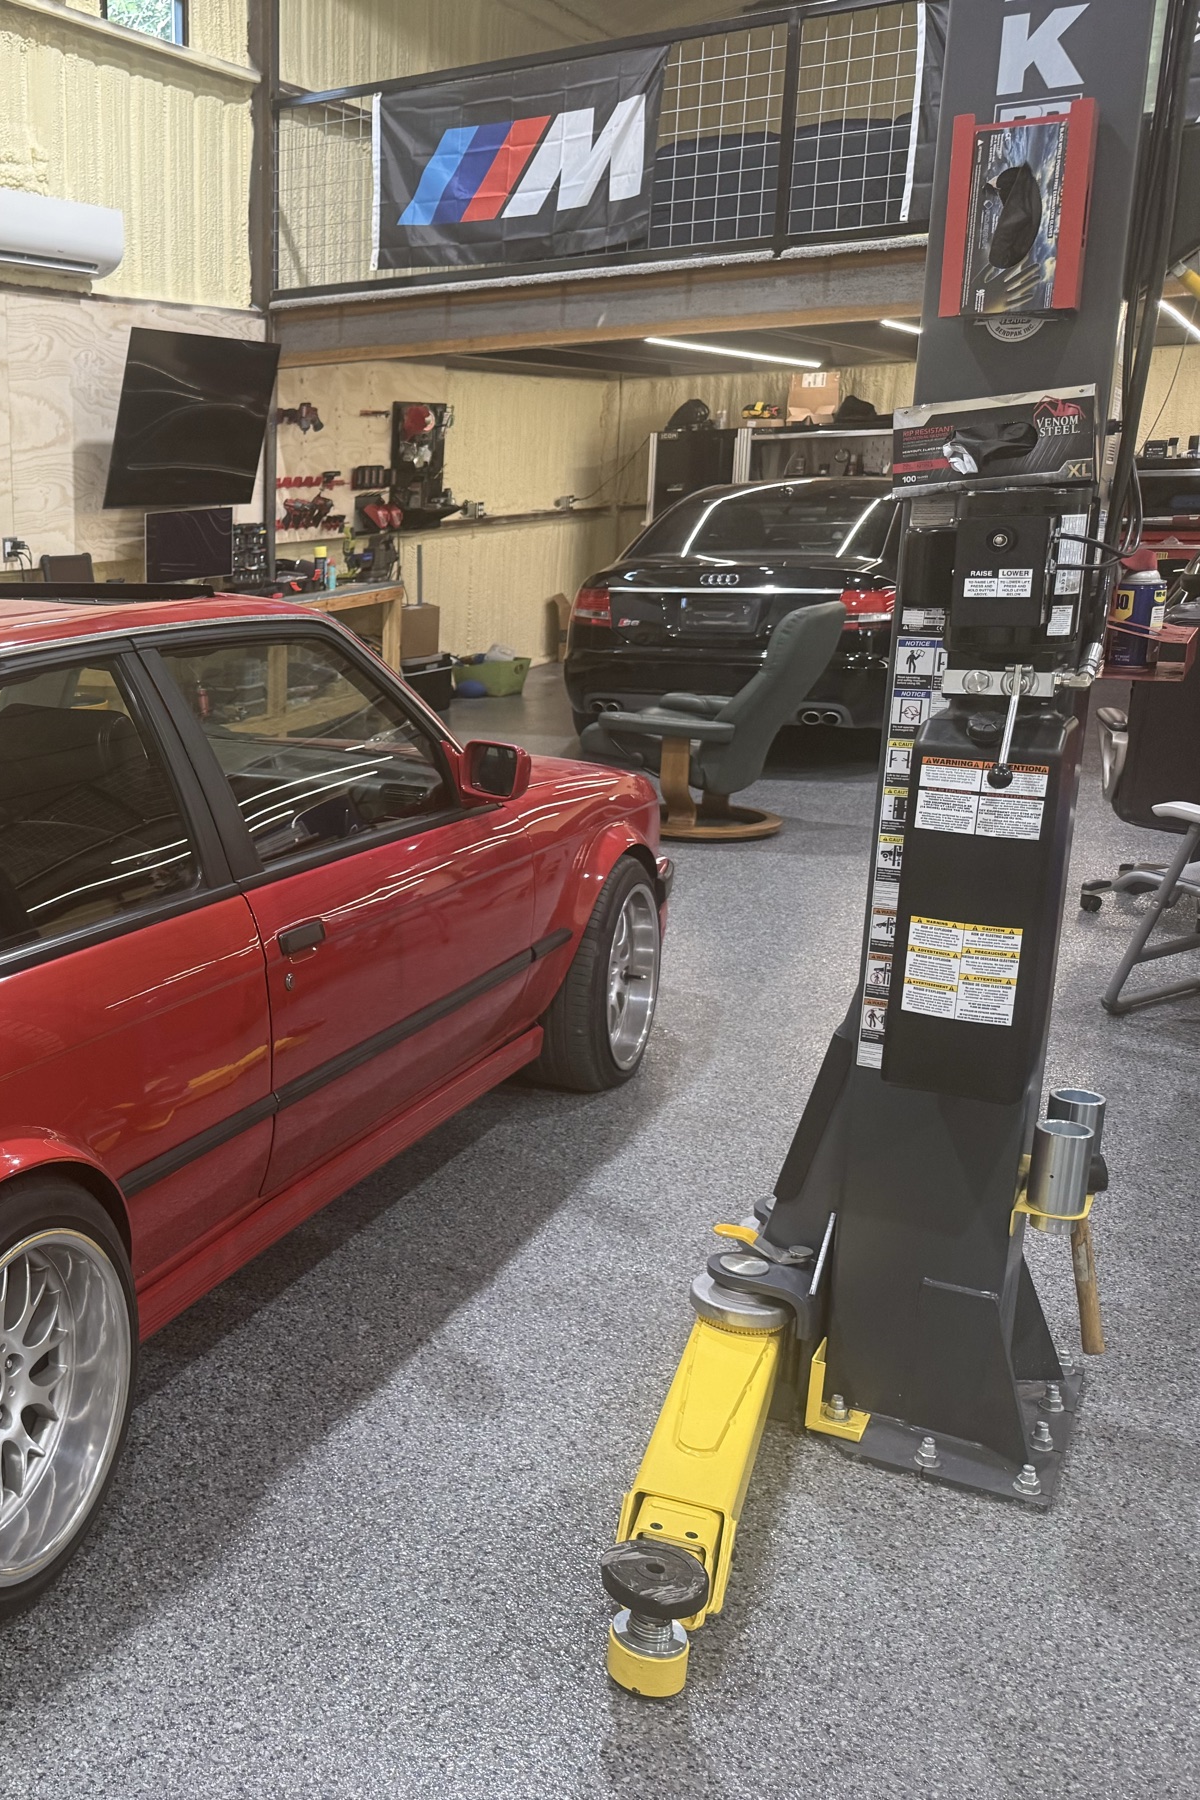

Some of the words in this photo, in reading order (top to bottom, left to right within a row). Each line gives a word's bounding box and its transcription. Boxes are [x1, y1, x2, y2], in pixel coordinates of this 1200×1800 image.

[996, 2, 1091, 96] K
[1036, 415, 1079, 429] VENOM
[914, 425, 954, 436] RESISTANT
[1067, 463, 1091, 479] XL
[902, 475, 917, 484] 100
[931, 758, 973, 767] WARNING
